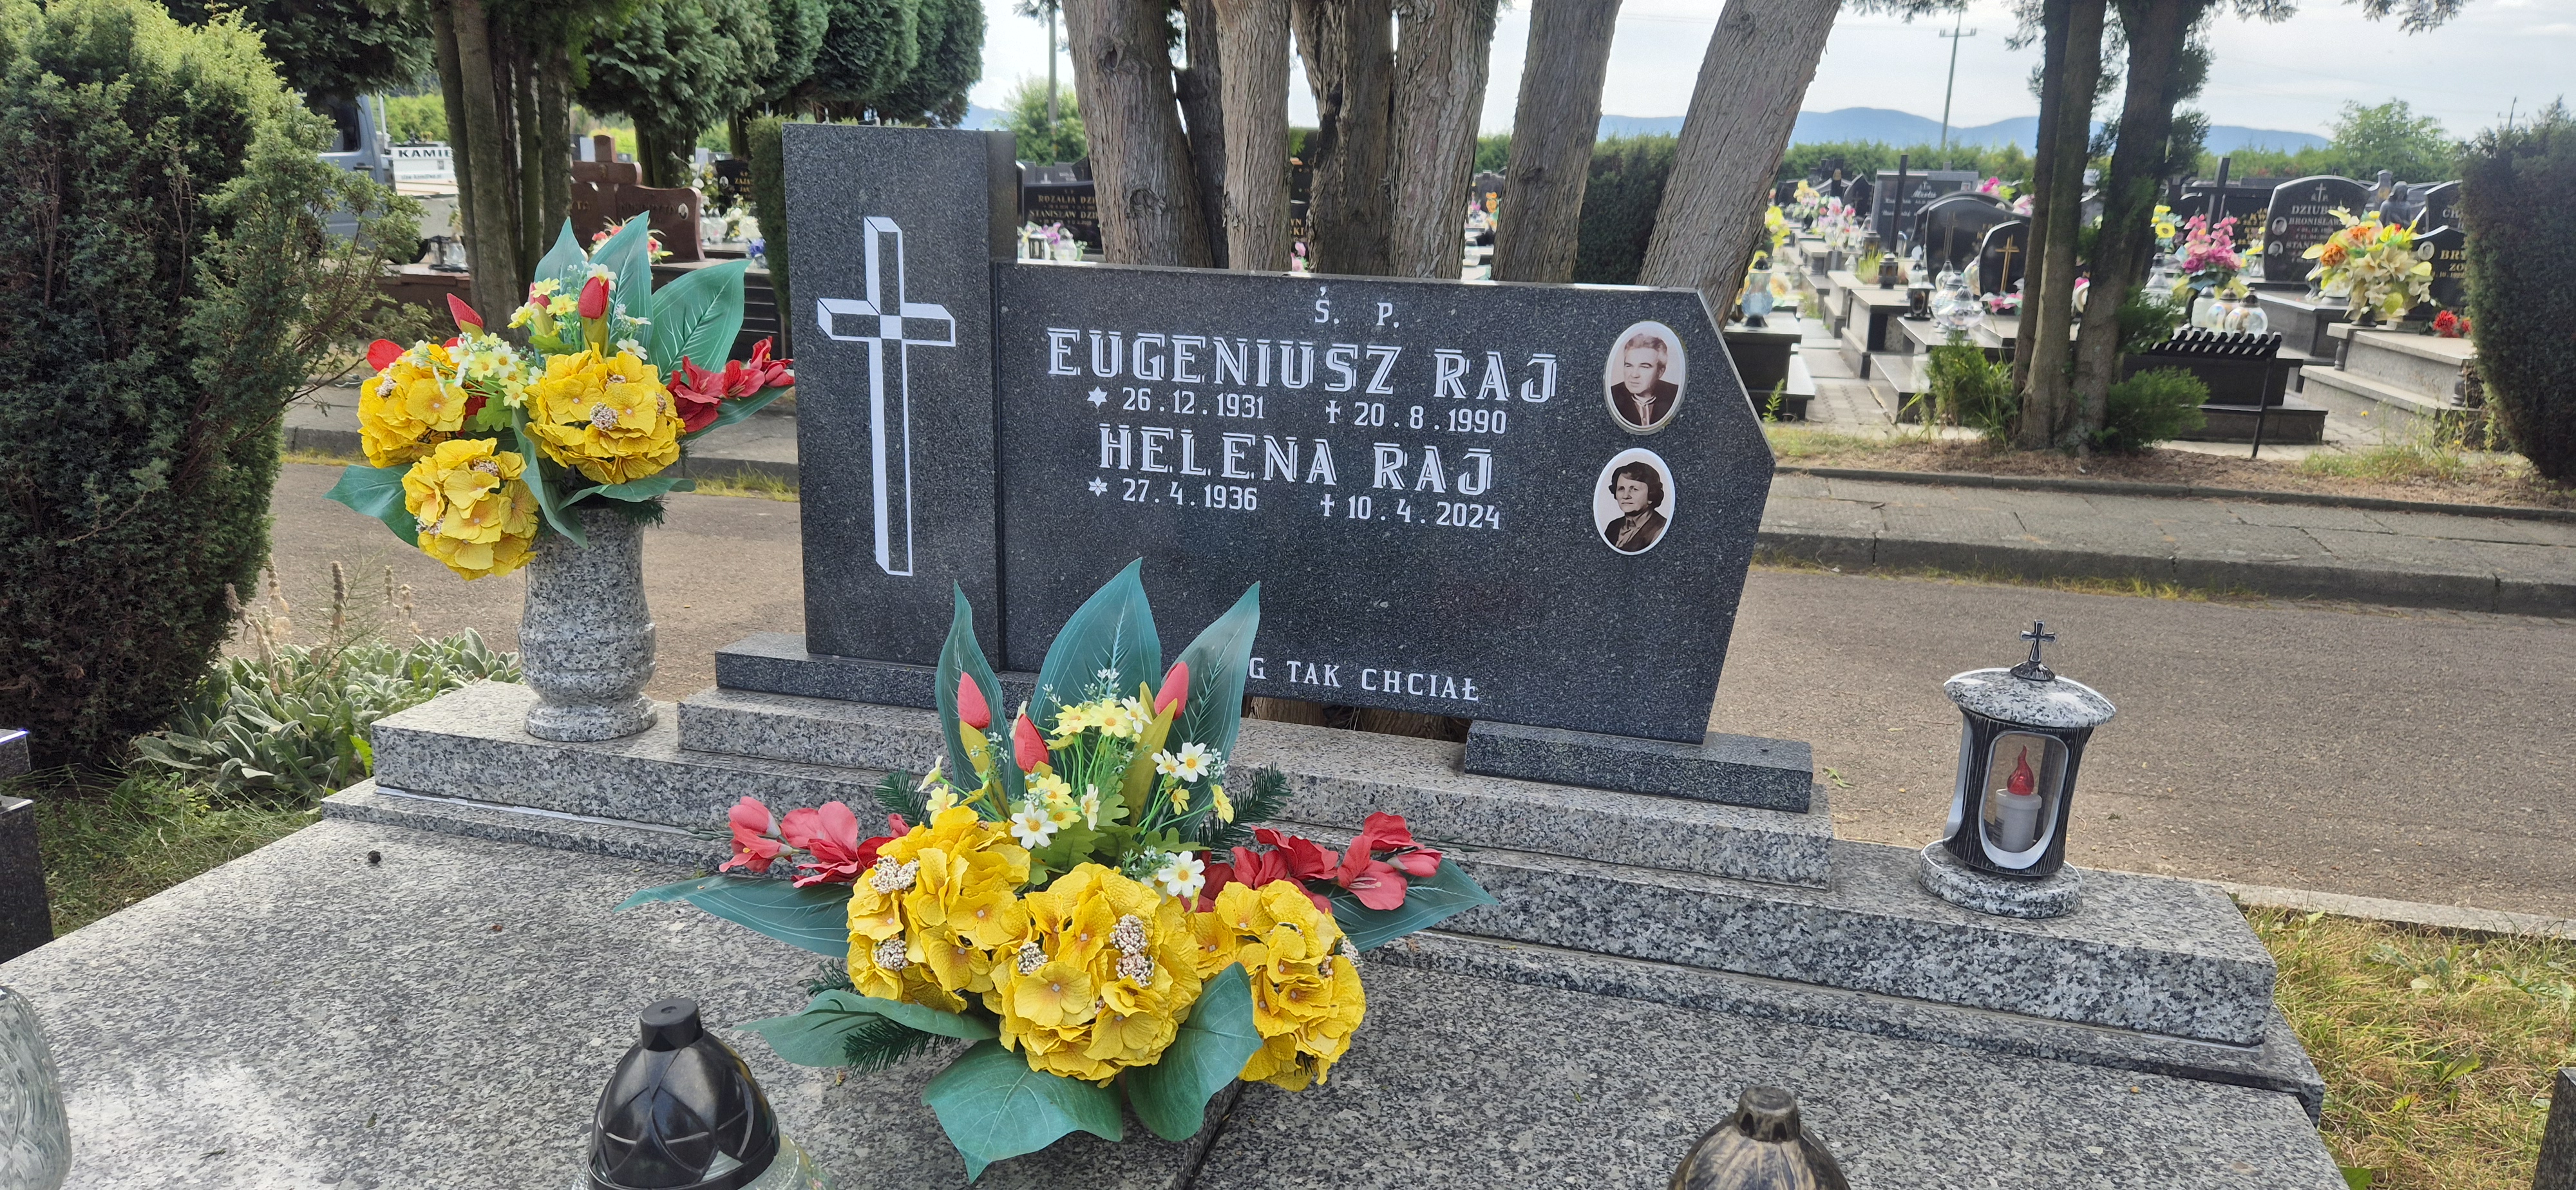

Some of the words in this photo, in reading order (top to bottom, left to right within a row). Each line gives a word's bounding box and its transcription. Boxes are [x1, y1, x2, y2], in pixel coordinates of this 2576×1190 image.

[1376, 302, 1399, 328] P.
[1046, 327, 1403, 395] EUGENIUSZ
[1433, 348, 1557, 403] RAJ
[1099, 423, 1337, 486] HELENA
[1372, 442, 1493, 496] RAJ
[1286, 659, 1341, 688] TAK
[1361, 668, 1480, 702] CHCIAŁ
